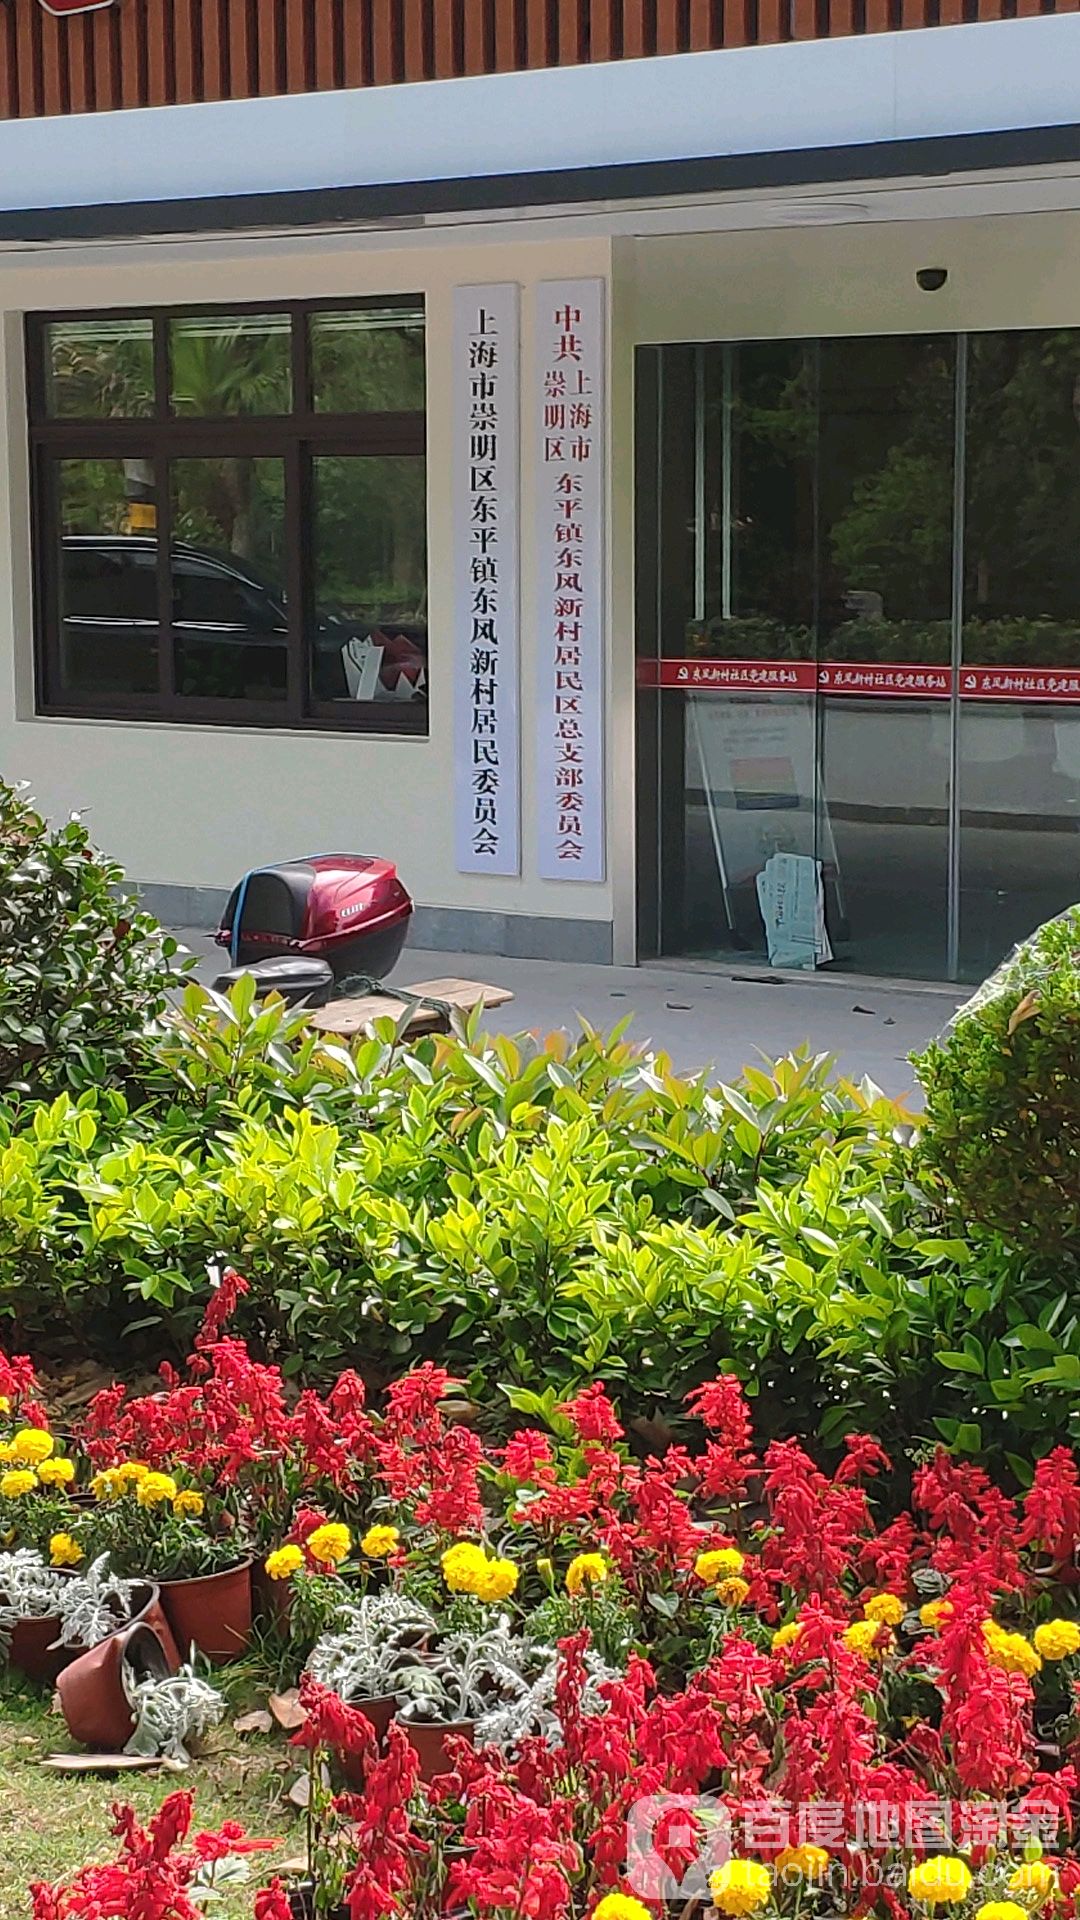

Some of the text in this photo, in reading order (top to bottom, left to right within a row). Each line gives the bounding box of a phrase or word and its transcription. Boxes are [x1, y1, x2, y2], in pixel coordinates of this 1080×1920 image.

[553, 304, 583, 362] 中共
[543, 370, 567, 462] 崇明区
[569, 369, 592, 462] 上海市
[469, 308, 499, 856] 上海市崇明区东平镇东风新村居民委员会
[554, 472, 584, 860] 东平镇东风新村居民区总支部委员会
